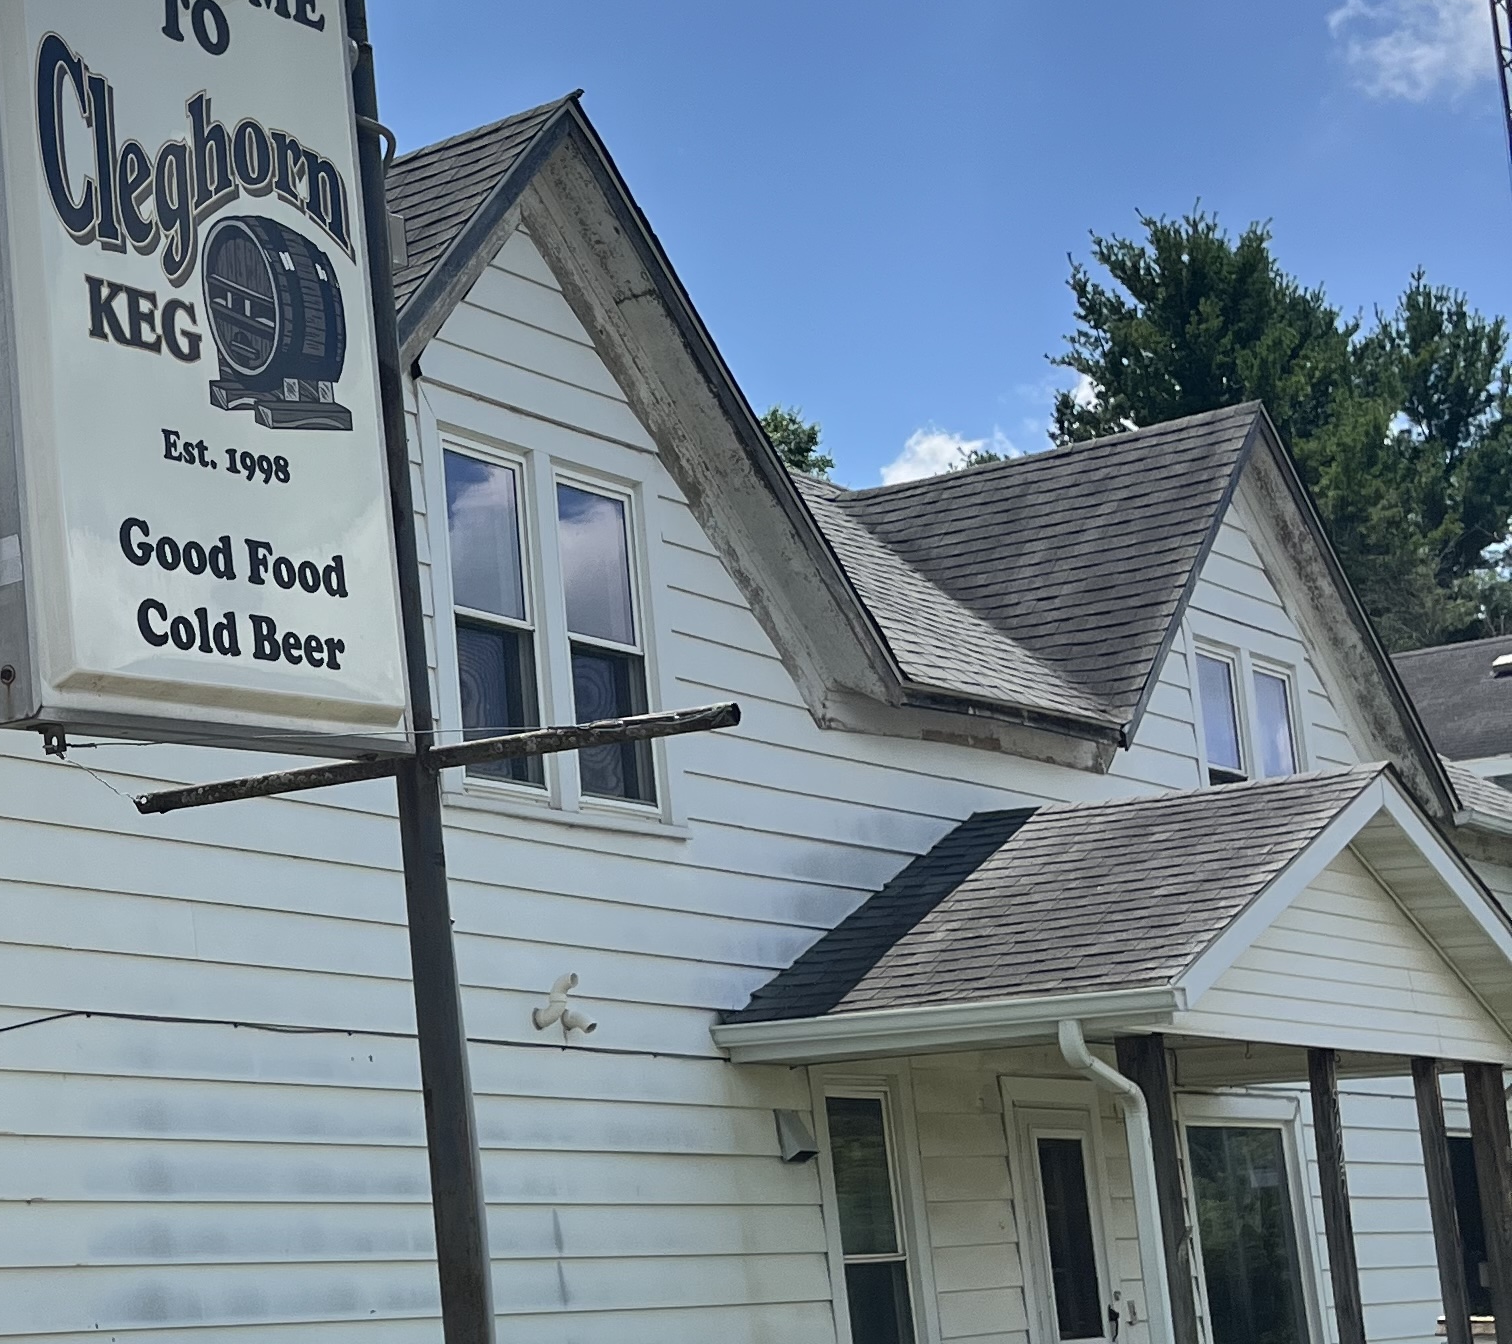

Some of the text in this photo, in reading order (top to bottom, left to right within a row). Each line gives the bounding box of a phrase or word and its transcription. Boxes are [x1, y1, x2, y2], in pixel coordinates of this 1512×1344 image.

[35, 31, 356, 287] Cleghorn
[84, 273, 203, 364] KEG
[161, 428, 291, 484] Est. 1998
[119, 517, 349, 598] Good Food
[136, 598, 346, 671] Cold Beer
